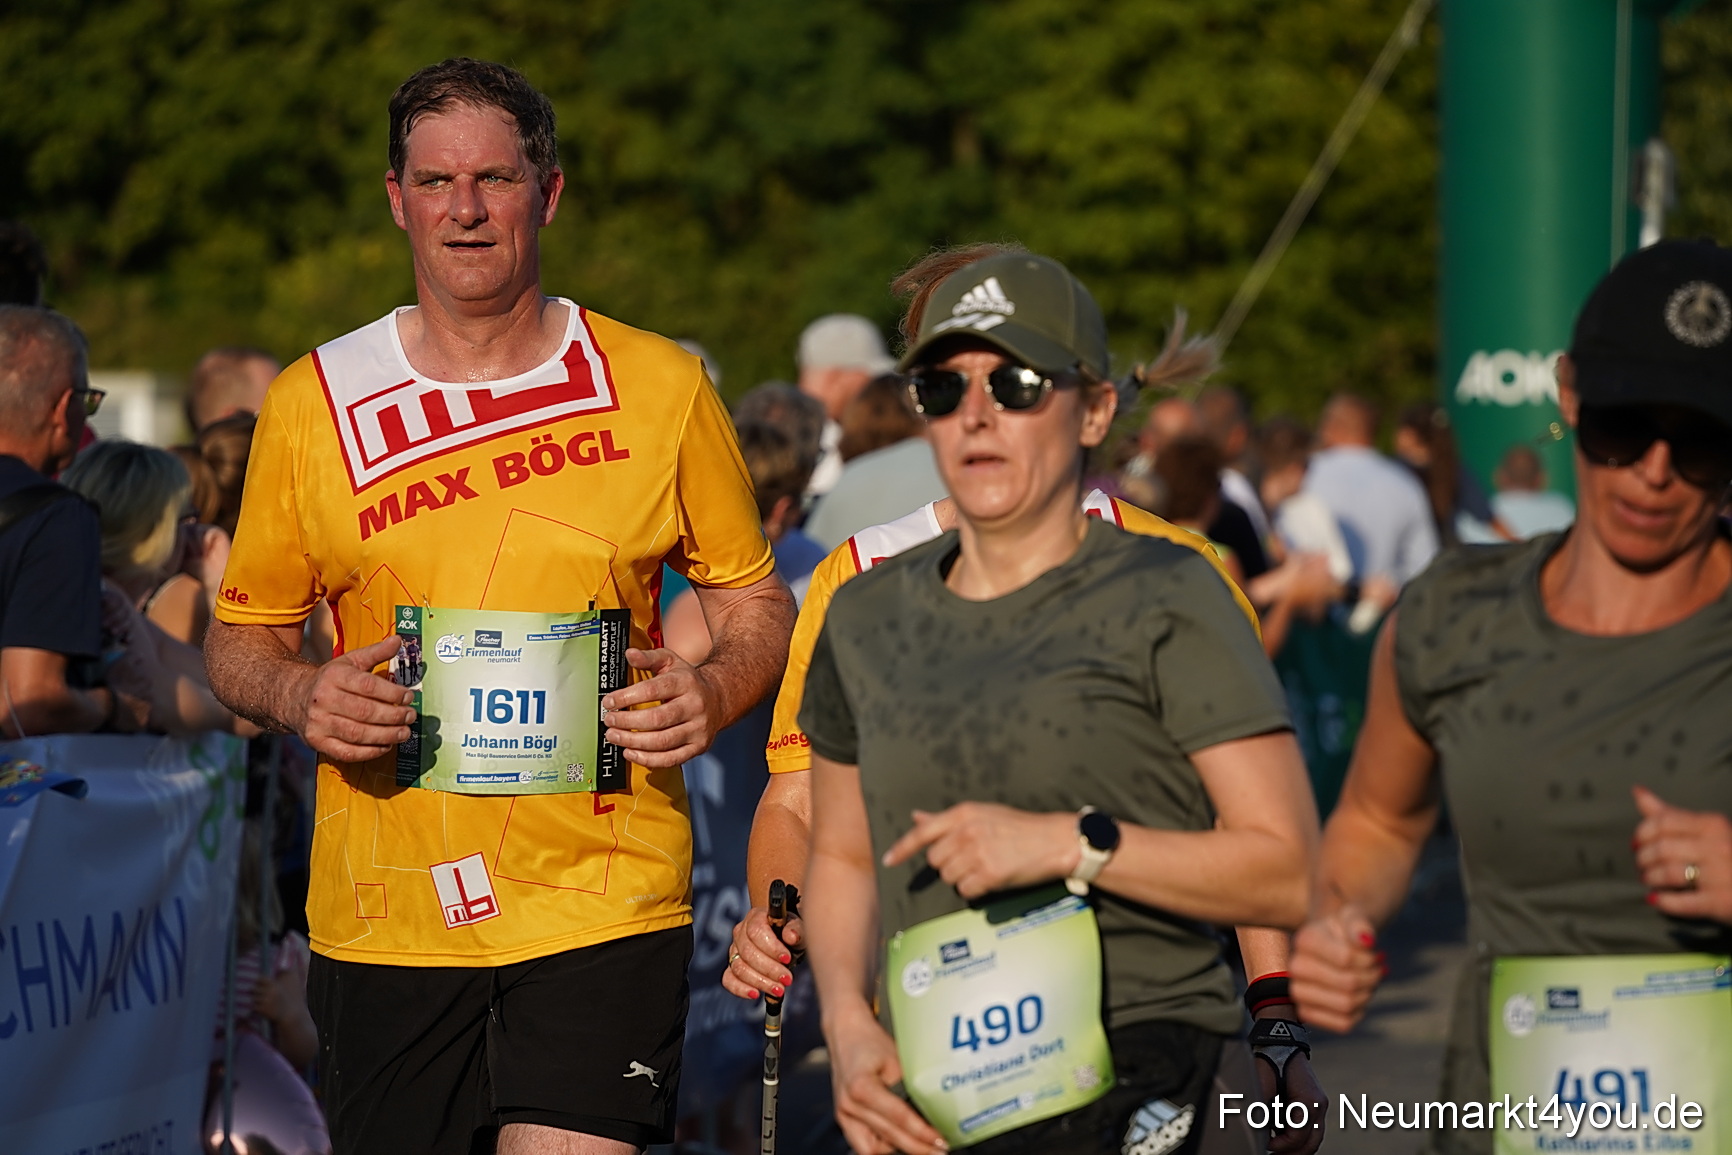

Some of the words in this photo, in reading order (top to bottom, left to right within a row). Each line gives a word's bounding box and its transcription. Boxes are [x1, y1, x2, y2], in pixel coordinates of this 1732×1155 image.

[357, 465, 480, 542] MAX
[491, 429, 631, 490] BÖGL
[397, 620, 418, 630] AOK
[465, 647, 523, 658] Firmenlauf
[601, 620, 609, 663] RABATT
[487, 656, 521, 664] neumarkt
[601, 664, 608, 673] %
[600, 675, 608, 689] 20
[469, 688, 546, 724] 1611
[461, 734, 519, 748] Johann
[523, 735, 557, 752] Bögl
[602, 732, 613, 777] HILT
[951, 995, 1044, 1052] 490
[1555, 1068, 1650, 1116] 491
